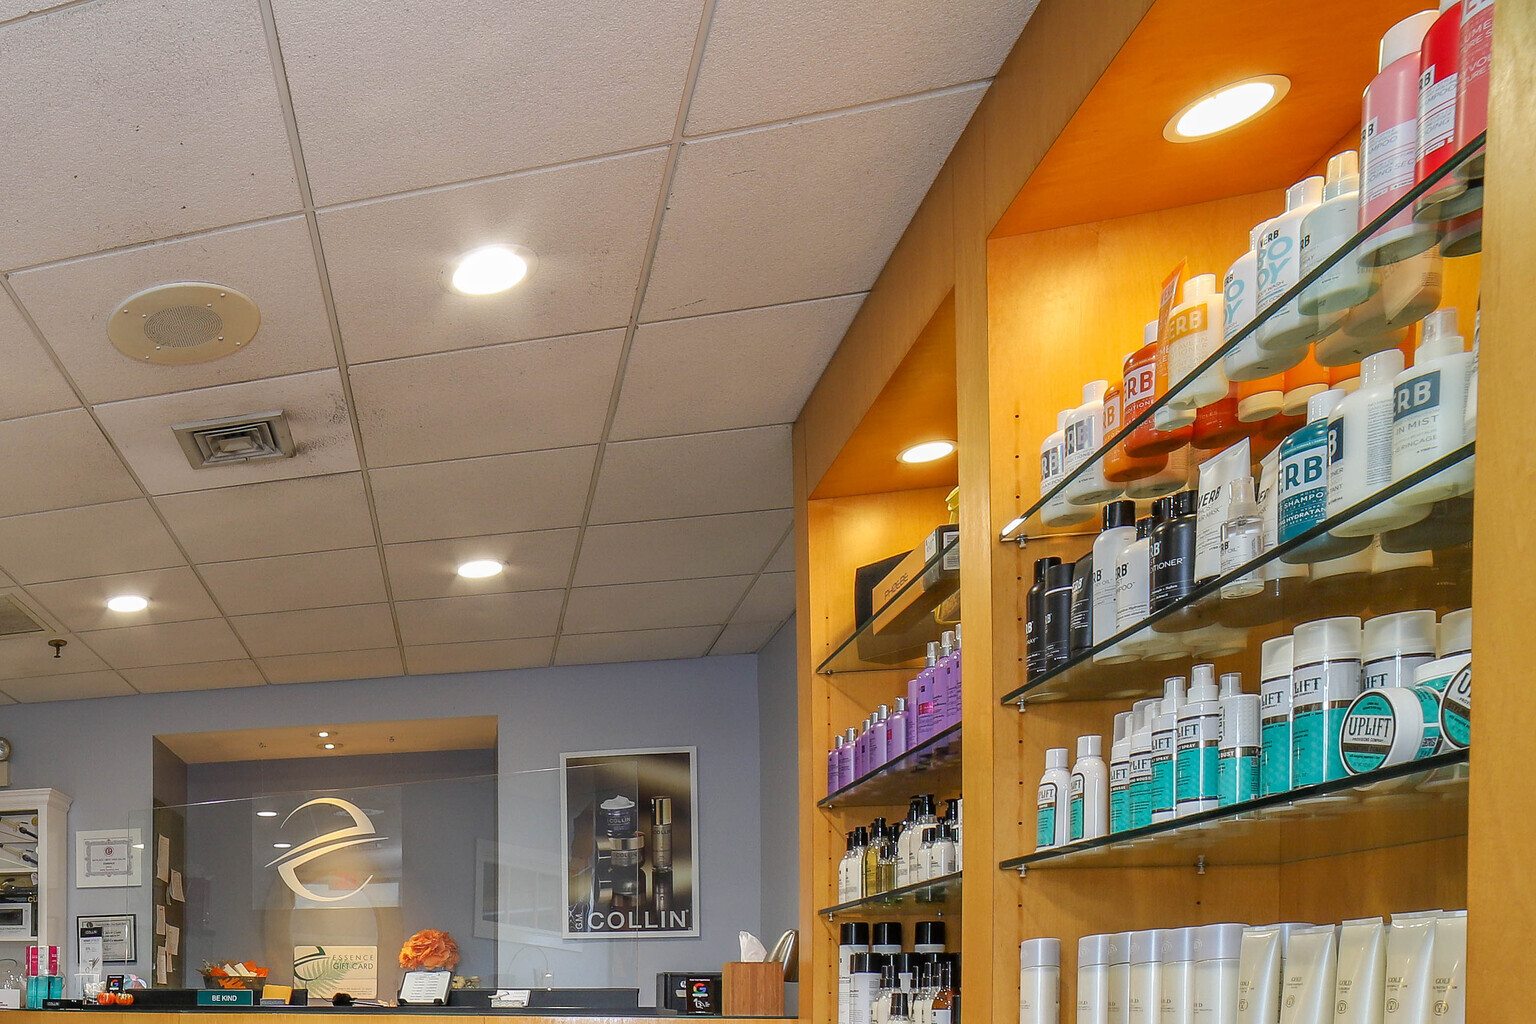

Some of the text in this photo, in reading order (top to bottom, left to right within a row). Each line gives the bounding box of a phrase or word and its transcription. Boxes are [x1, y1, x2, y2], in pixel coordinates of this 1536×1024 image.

[1301, 234, 1310, 250] RB
[1170, 309, 1202, 340] ERB
[1128, 371, 1153, 400] RB
[1398, 381, 1431, 413] RB
[1408, 415, 1438, 430] MIST
[1067, 425, 1089, 454] RB
[1042, 452, 1059, 473] RB
[1285, 455, 1323, 490] RB
[1198, 486, 1221, 508] VERB
[1284, 491, 1326, 509] SHAMPO
[1286, 506, 1327, 524] HYDRATAN
[1150, 541, 1160, 558] RB
[1092, 570, 1102, 583] RB
[1116, 563, 1128, 580] RB
[884, 572, 909, 600] PHOEBE
[1294, 677, 1321, 693] LIFT
[1262, 691, 1284, 706] LIFT
[1178, 724, 1199, 737] LIFT
[1348, 717, 1391, 738] UPLIFT
[1152, 737, 1172, 750] LIFT
[1111, 768, 1127, 780] LIFT
[587, 911, 686, 930] COLLIN
